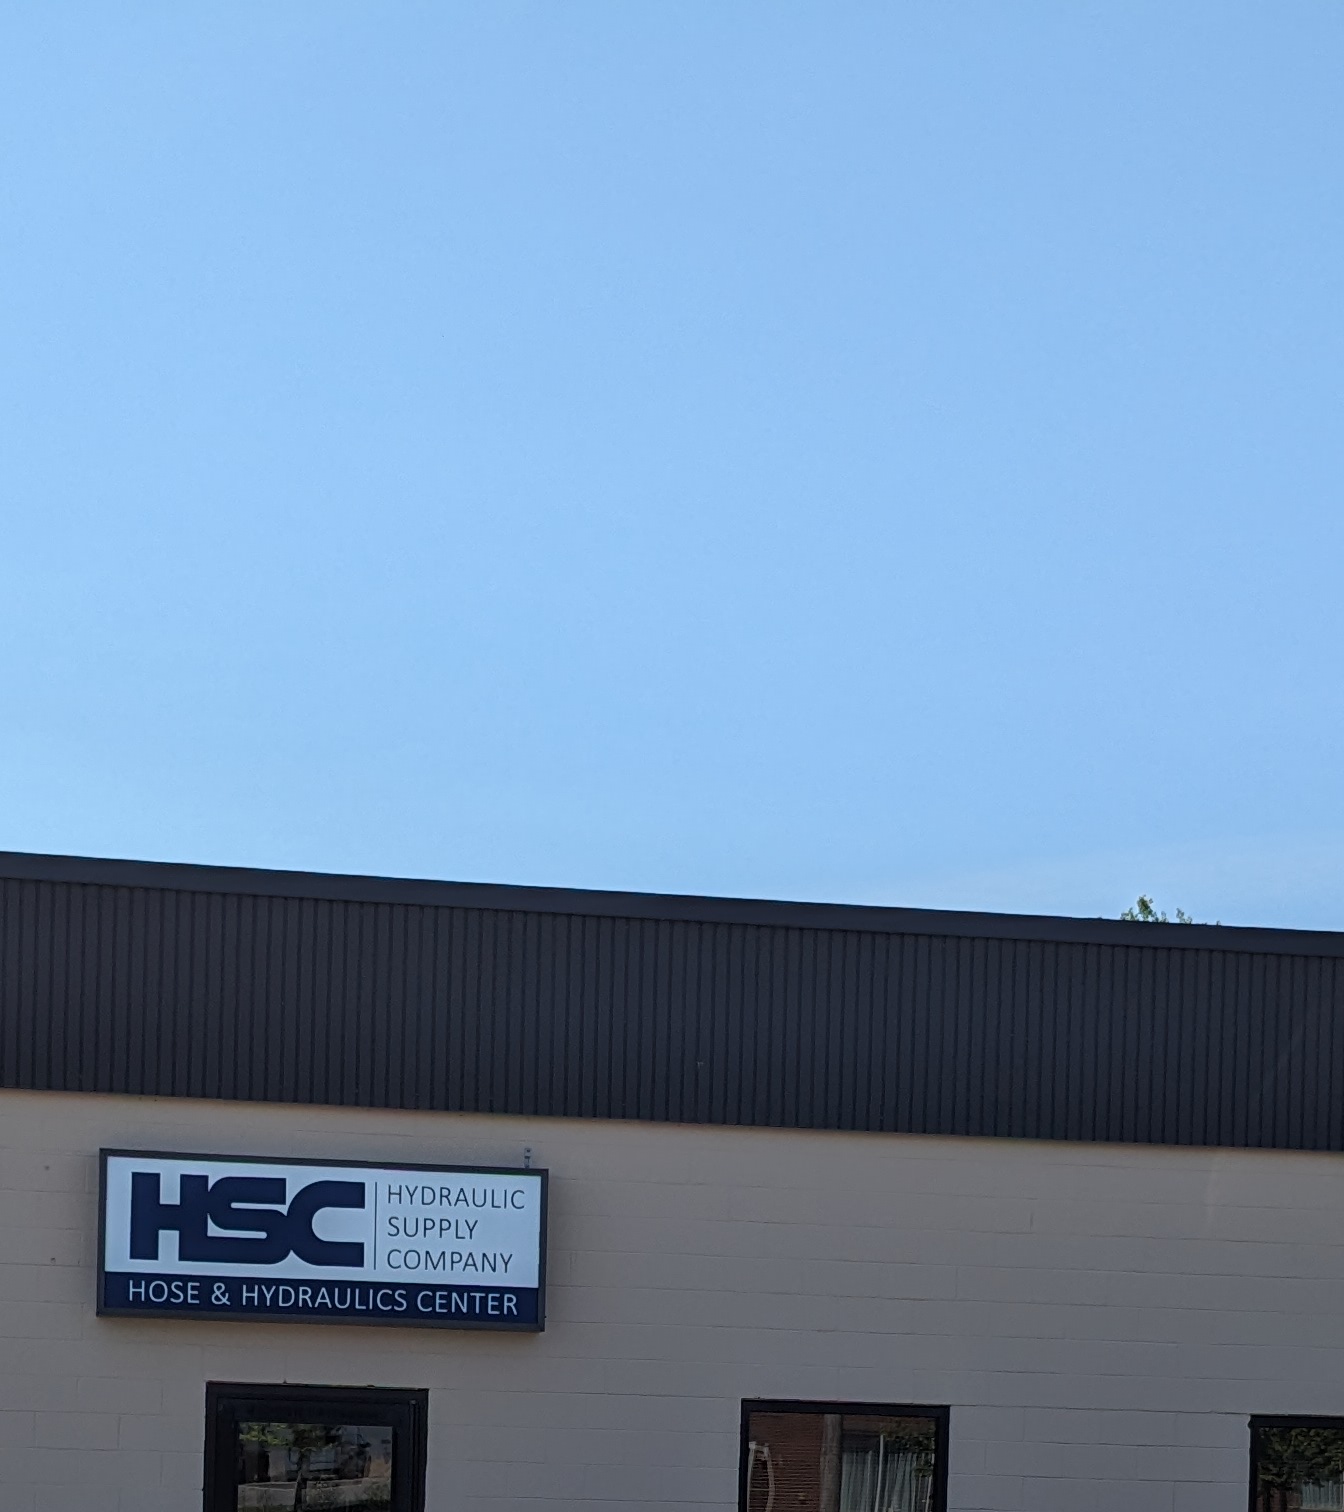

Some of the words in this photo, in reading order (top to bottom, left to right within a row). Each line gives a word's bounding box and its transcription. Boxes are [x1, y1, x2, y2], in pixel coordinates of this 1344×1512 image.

[386, 1184, 526, 1211] HYDRAULIC
[129, 1171, 366, 1268] HSC
[386, 1216, 480, 1241] SUPPLY
[386, 1248, 515, 1275] COMPANY
[128, 1279, 201, 1305] HOSE
[211, 1282, 231, 1307] &
[241, 1284, 408, 1313] HYDRAULICS
[416, 1290, 519, 1317] CENTER
